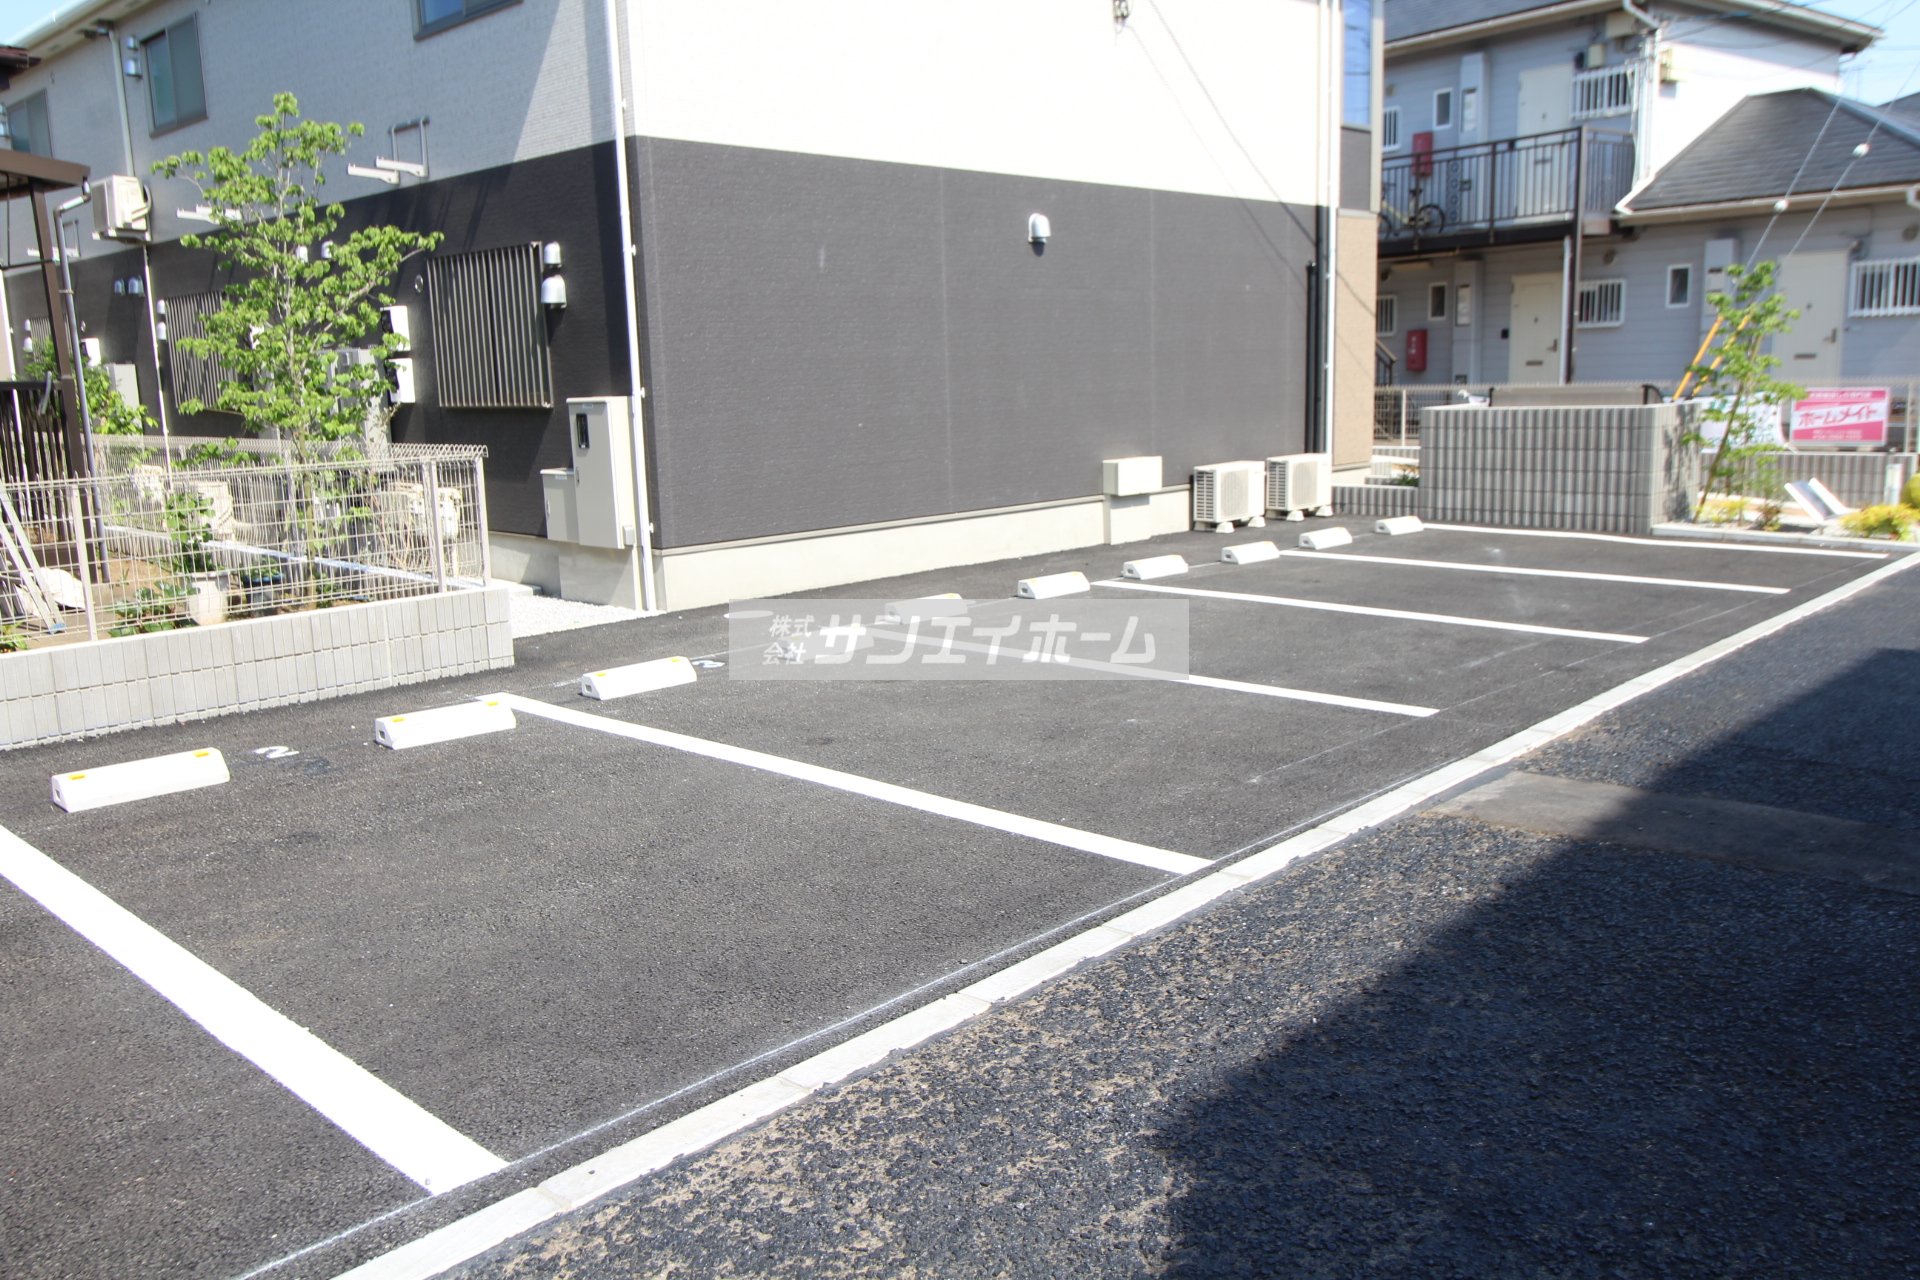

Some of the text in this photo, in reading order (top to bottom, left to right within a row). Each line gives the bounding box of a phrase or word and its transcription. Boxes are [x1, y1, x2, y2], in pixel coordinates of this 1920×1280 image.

[1799, 405, 1877, 426] ホームメイト
[252, 746, 300, 759] 2
